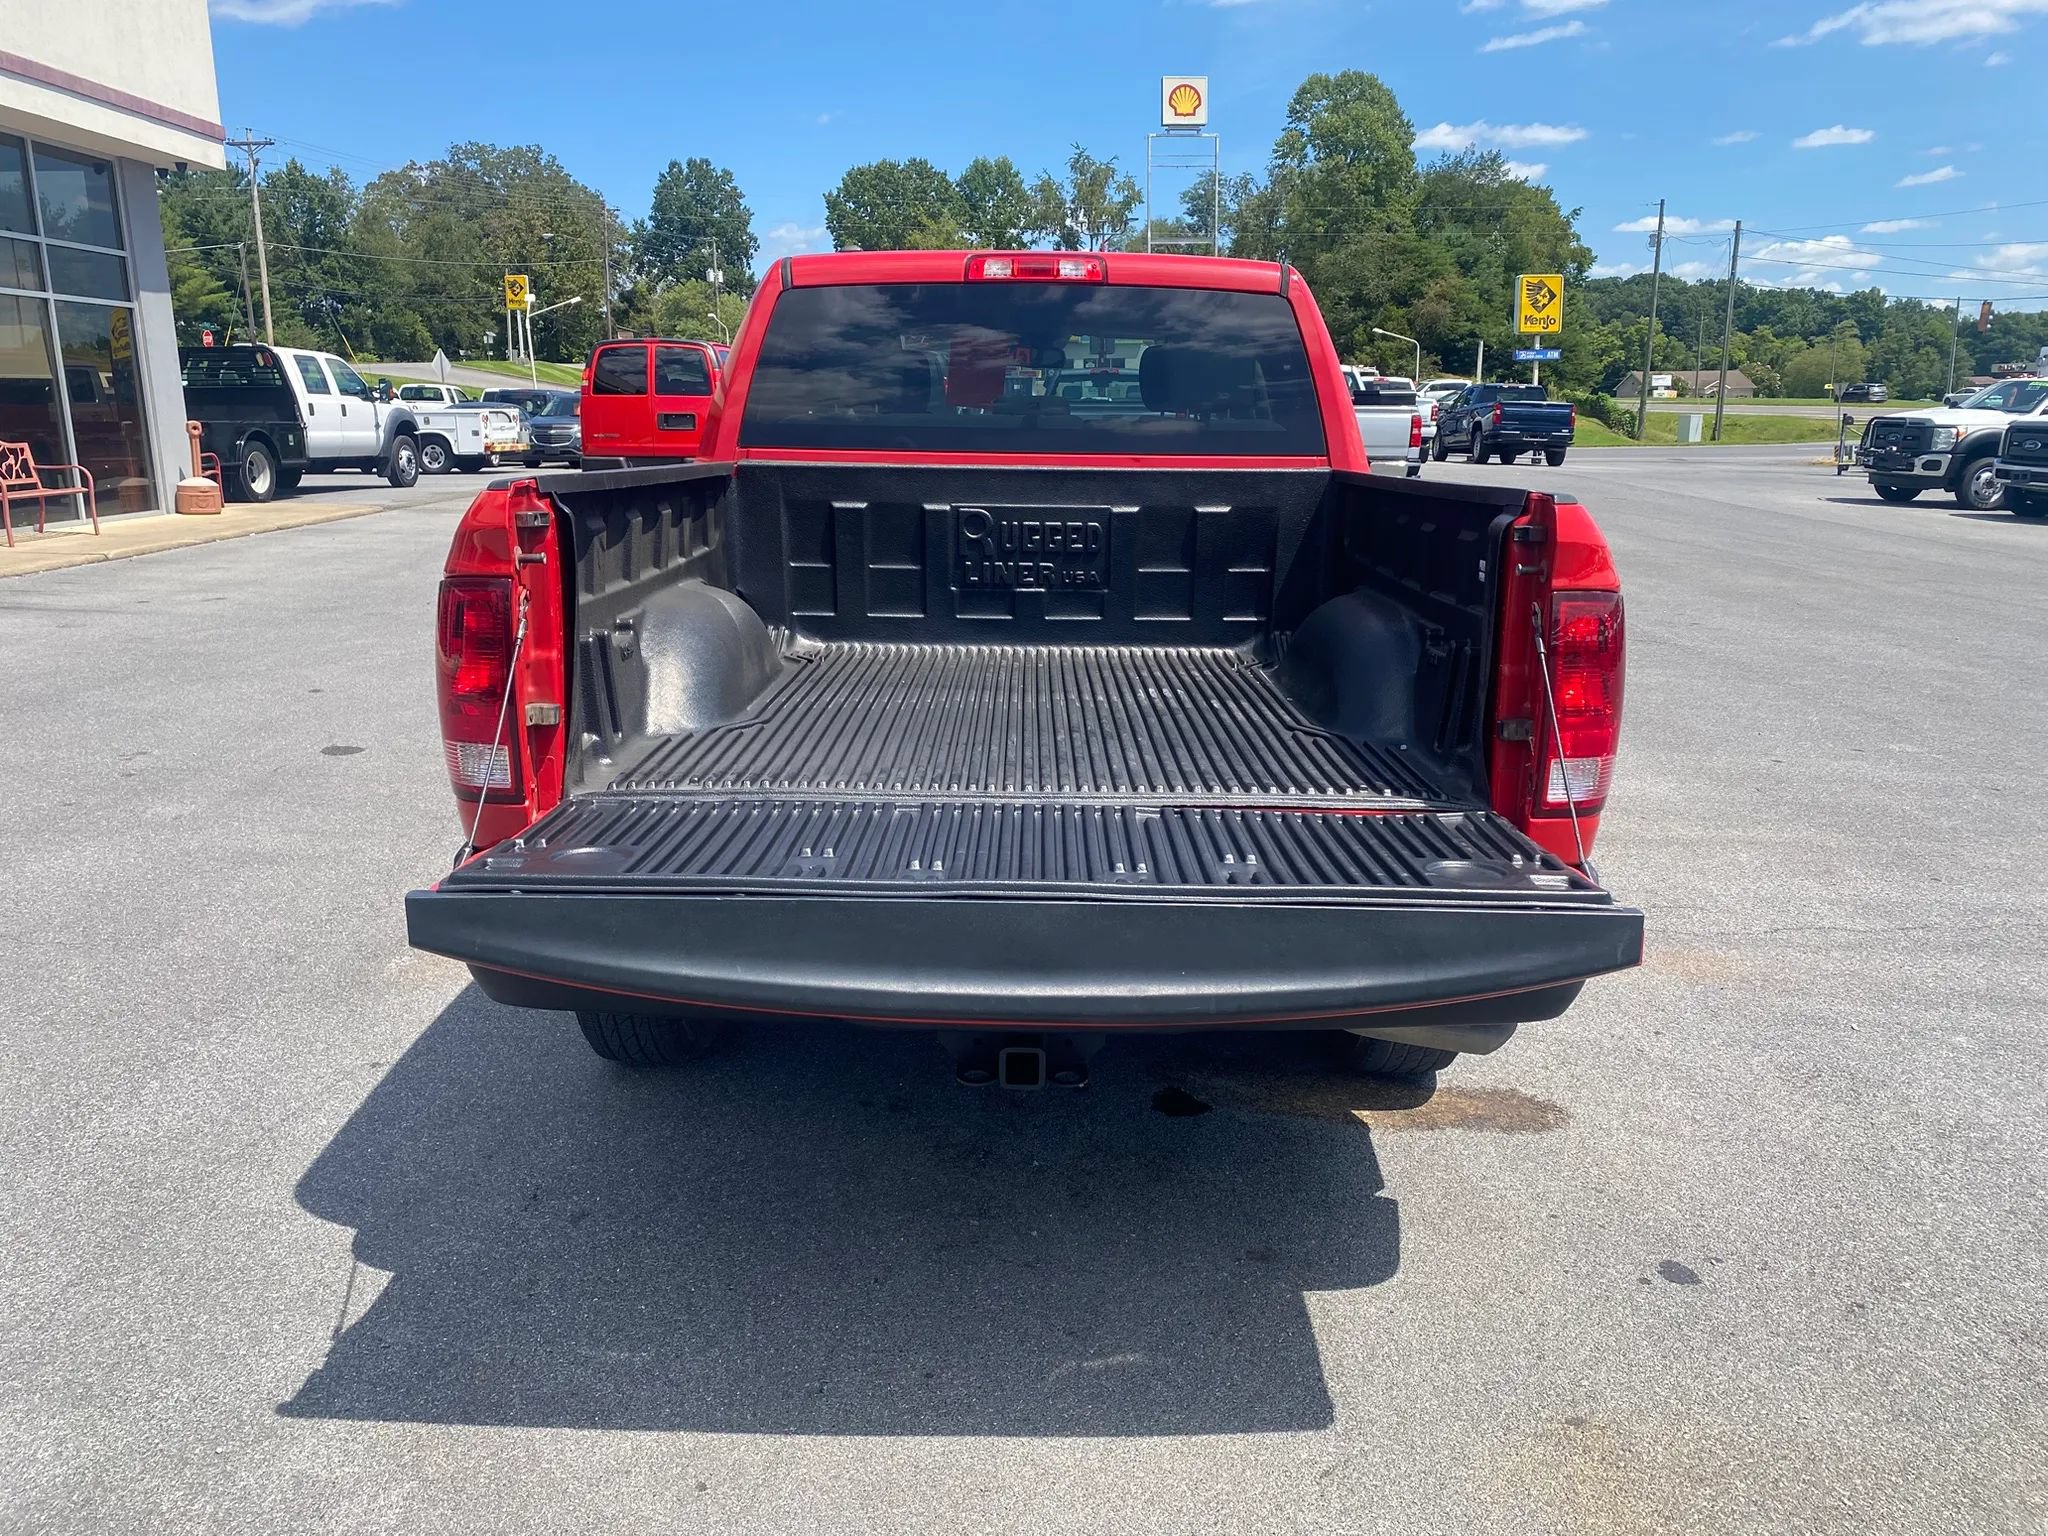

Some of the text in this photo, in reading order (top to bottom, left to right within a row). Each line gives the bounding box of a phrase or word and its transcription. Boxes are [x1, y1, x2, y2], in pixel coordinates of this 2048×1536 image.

[1524, 314, 1556, 329] Kenjo
[958, 508, 1103, 556] RUGGED
[964, 561, 1102, 585] LINER USA
